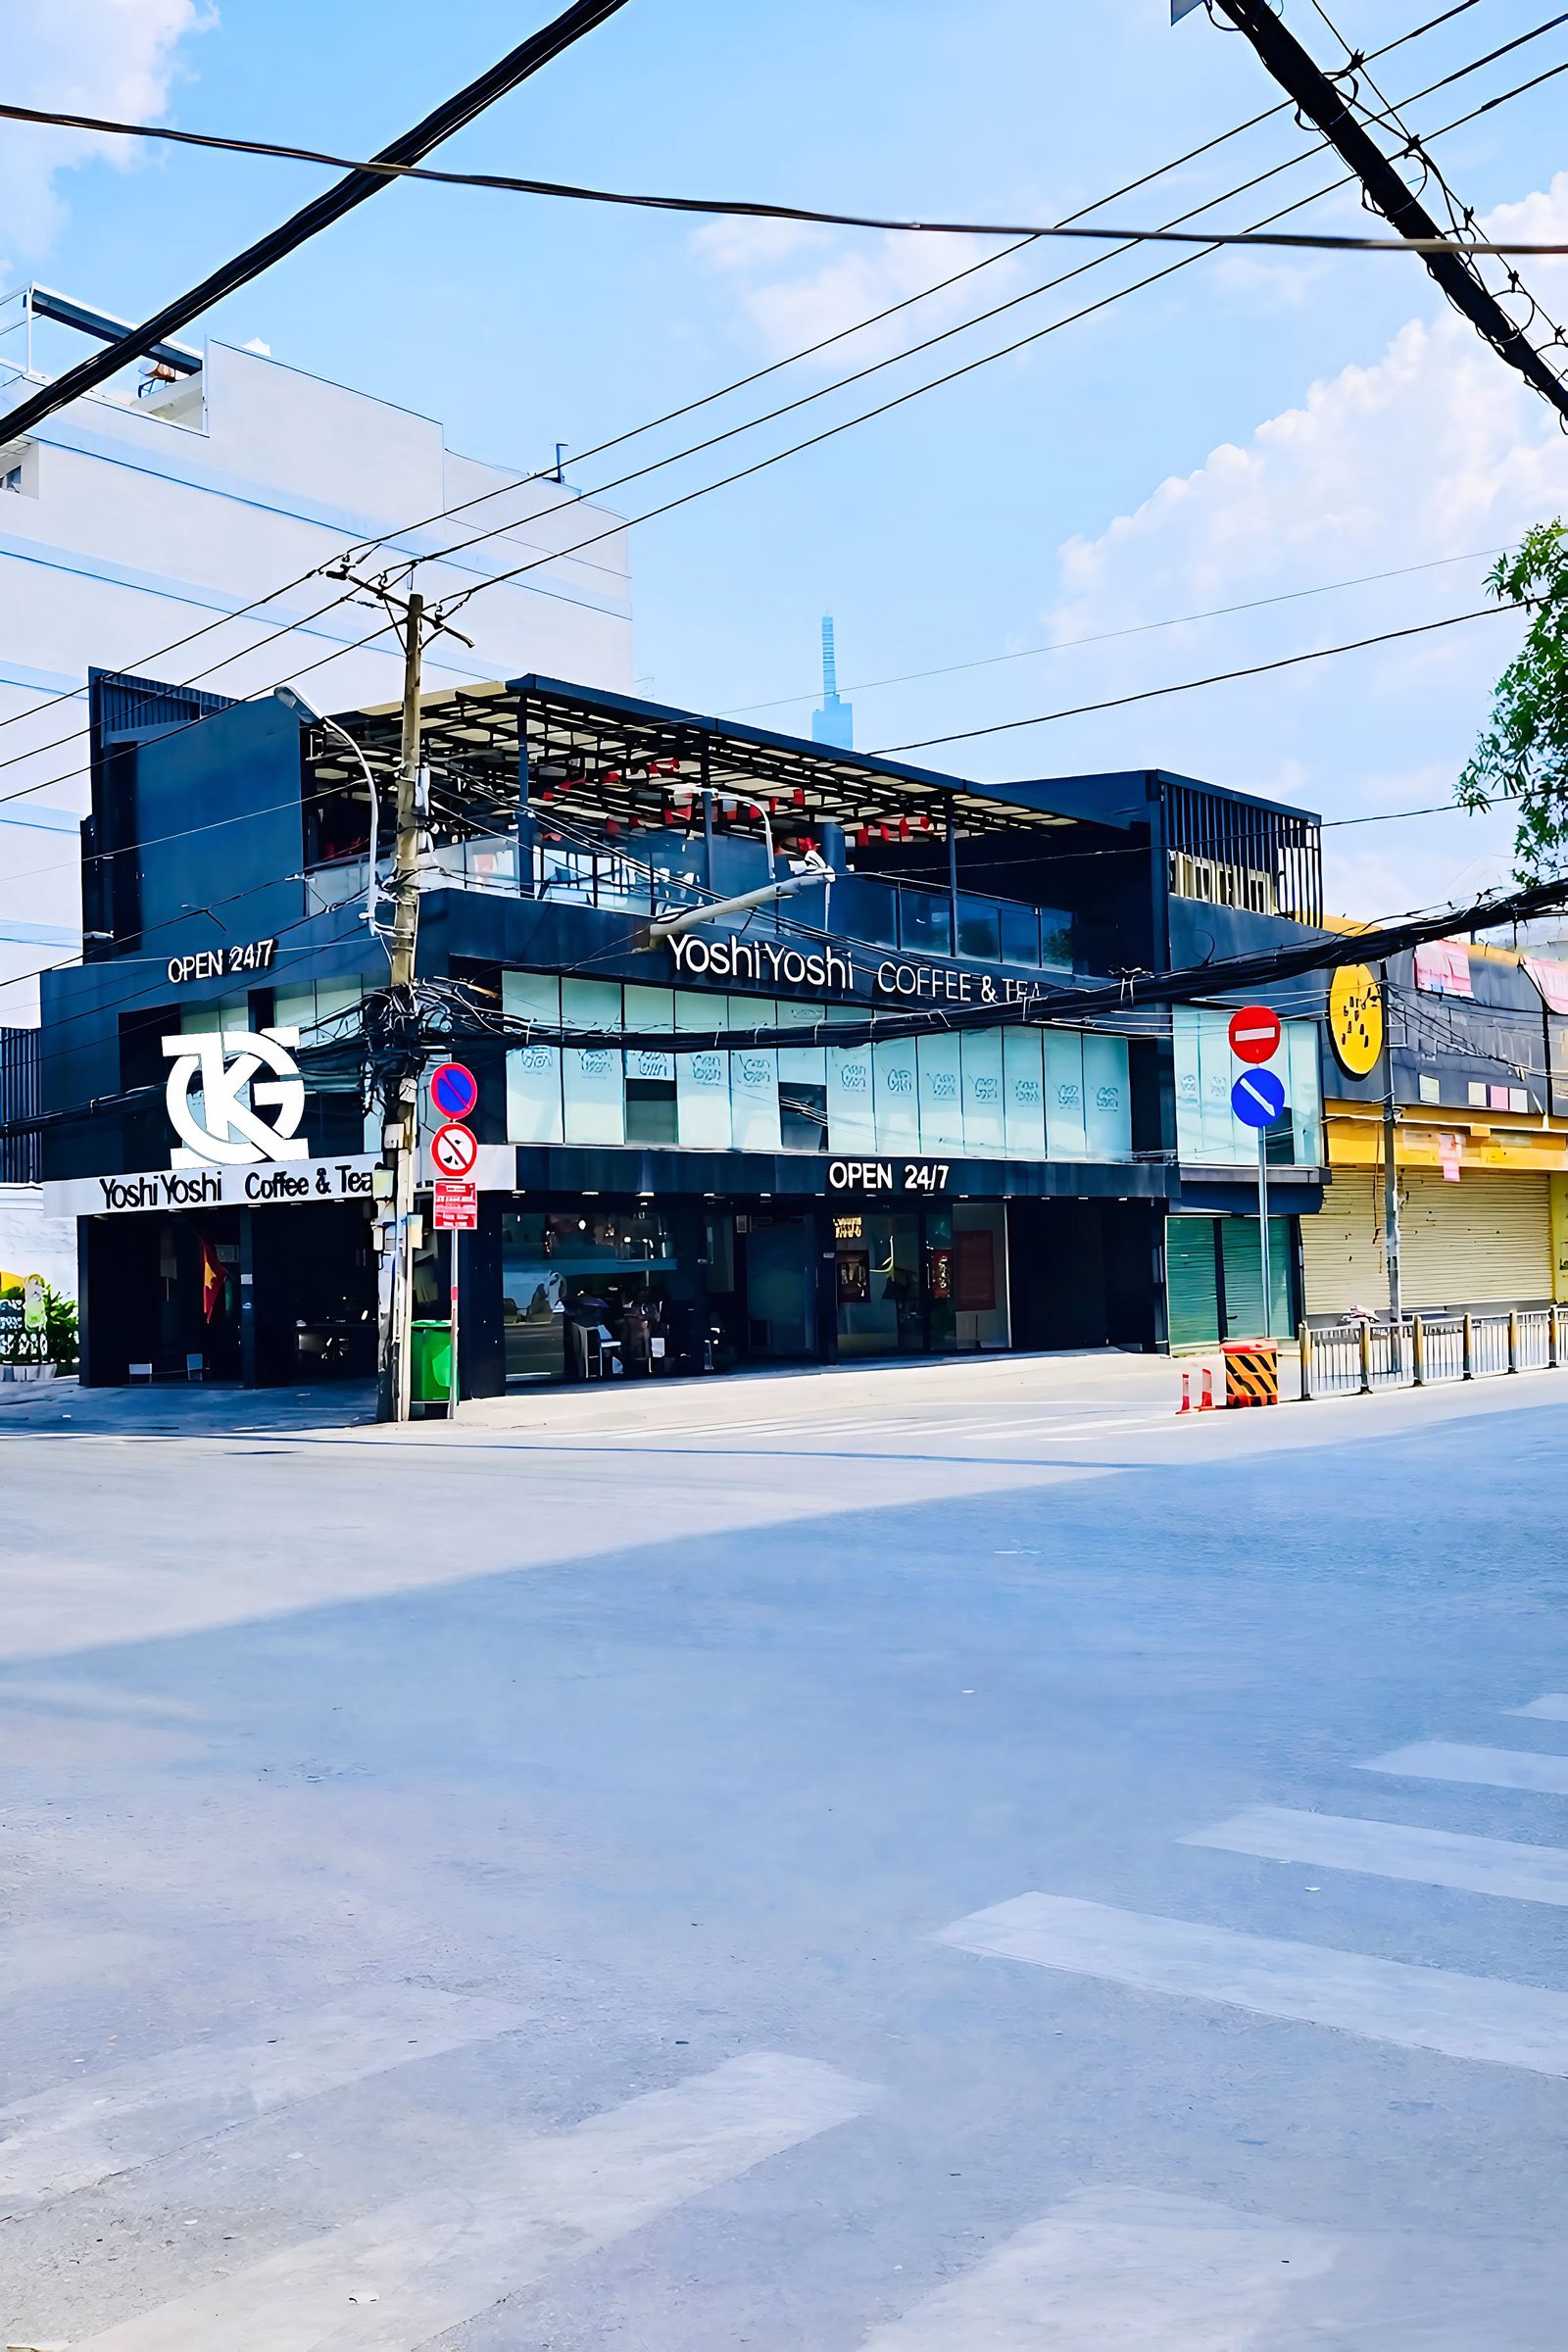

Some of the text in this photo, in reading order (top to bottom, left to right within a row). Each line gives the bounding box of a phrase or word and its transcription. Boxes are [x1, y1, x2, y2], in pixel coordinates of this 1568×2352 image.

[168, 938, 274, 984] OPEN 24/7
[878, 961, 971, 1002] COFFEE
[981, 975, 999, 1004] &
[245, 1170, 309, 1200] Coffee
[316, 1167, 332, 1194] &
[335, 1164, 373, 1194] Tea
[829, 1161, 950, 1190] OPEN 24/7
